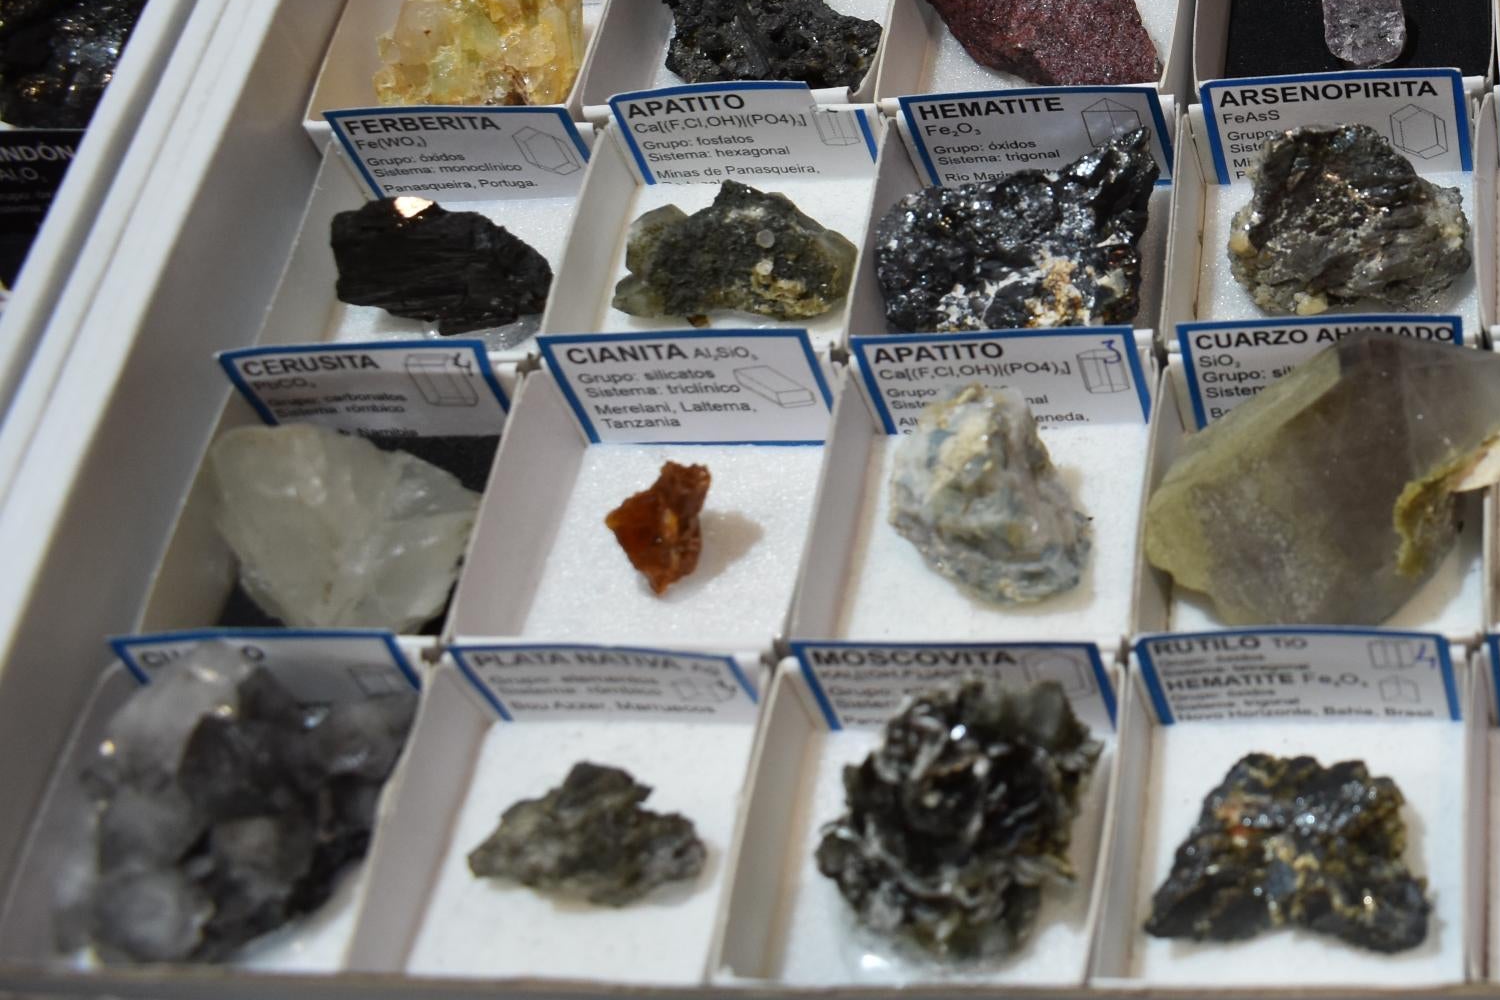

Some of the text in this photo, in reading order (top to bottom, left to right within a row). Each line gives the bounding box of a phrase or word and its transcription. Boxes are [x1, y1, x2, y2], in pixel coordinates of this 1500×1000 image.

[1219, 80, 1438, 108] ARSENOPIRITA
[628, 93, 745, 119] APATITO
[918, 96, 1064, 121] HEMATITE
[344, 115, 501, 136] FERBERITA
[1222, 109, 1281, 125] FeAsS
[715, 145, 791, 160] hexagonal
[440, 161, 522, 175] monoclínico
[656, 163, 820, 180] Minas de Panasqueira,
[1196, 329, 1308, 351] CUARZO
[567, 343, 688, 366] CIANITA
[874, 342, 1003, 365] APATITO
[1102, 339, 1122, 364] 3
[242, 354, 380, 377] CERUSITA
[602, 416, 682, 430] Tanzania
[1153, 636, 1262, 655] RUTILO
[1166, 673, 1296, 692] HEMATITE
